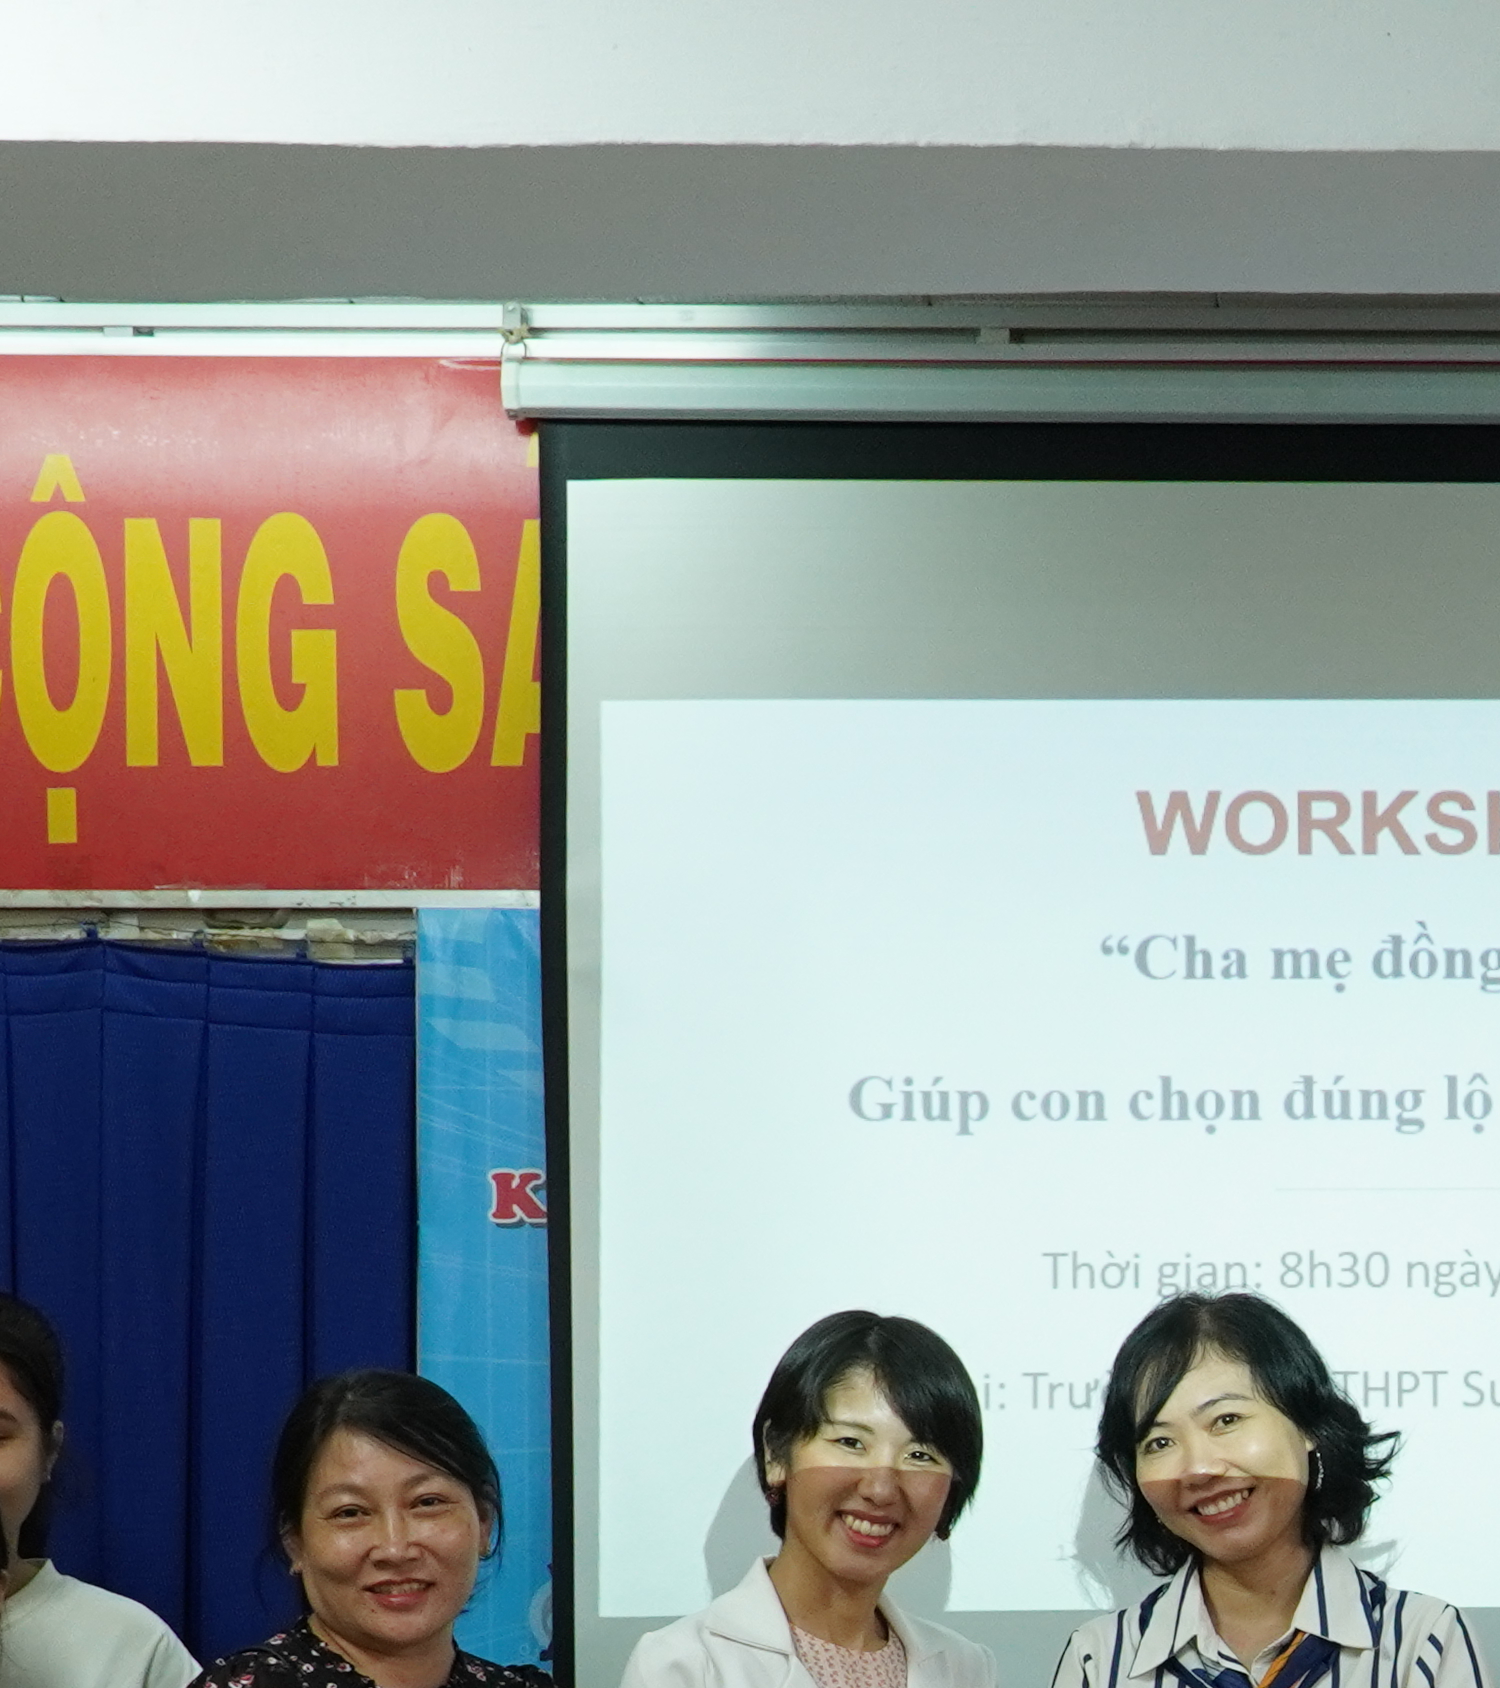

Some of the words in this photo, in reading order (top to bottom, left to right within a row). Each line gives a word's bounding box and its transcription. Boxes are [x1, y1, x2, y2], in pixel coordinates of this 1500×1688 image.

[1100, 934, 1250, 981] “Cha
[1270, 946, 1353, 994] mẹ
[848, 1075, 991, 1137] Giúp
[1010, 1088, 1108, 1123] con
[1127, 1074, 1263, 1136] chọn
[1282, 1074, 1426, 1136] đúng
[1443, 1071, 1494, 1135] lộ
[1042, 1250, 1141, 1290] Thời
[1157, 1251, 1262, 1300] gian:
[1279, 1249, 1391, 1289] 8h30
[1021, 1370, 1112, 1410] Trư
[1332, 1369, 1449, 1409] THPT
